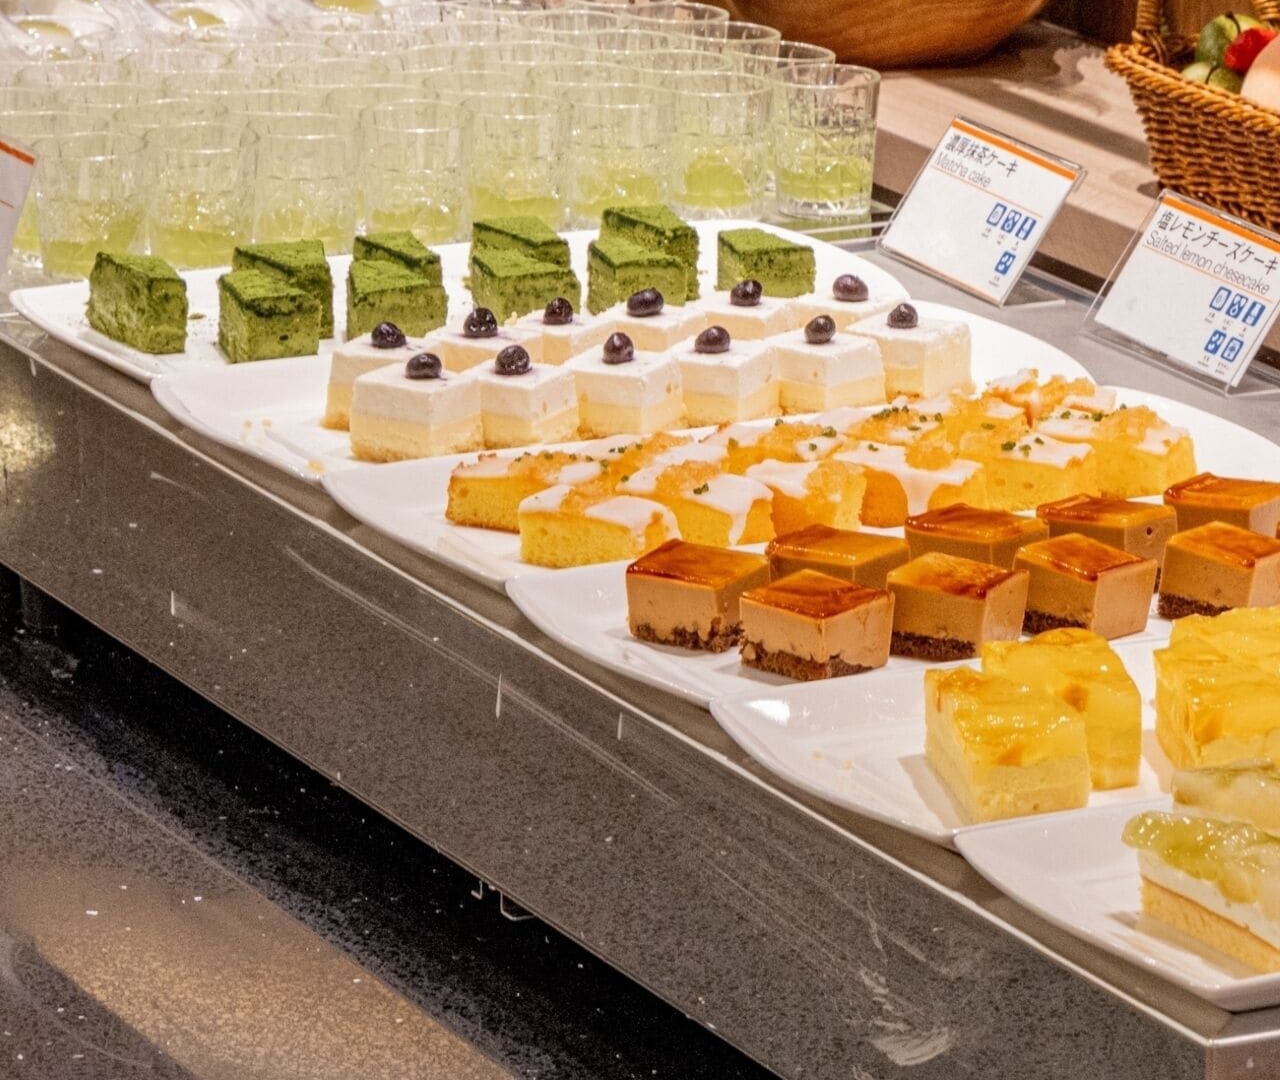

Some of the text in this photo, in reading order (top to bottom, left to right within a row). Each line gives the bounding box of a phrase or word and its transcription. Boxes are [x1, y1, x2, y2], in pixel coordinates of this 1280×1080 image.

[935, 151, 991, 187] Matcha cake
[944, 133, 1018, 178] 濃厚抹茶ケーキ
[1146, 230, 1270, 295] Salted lemon chesecake
[1157, 209, 1278, 275] 塩レモンチーズケーキ
